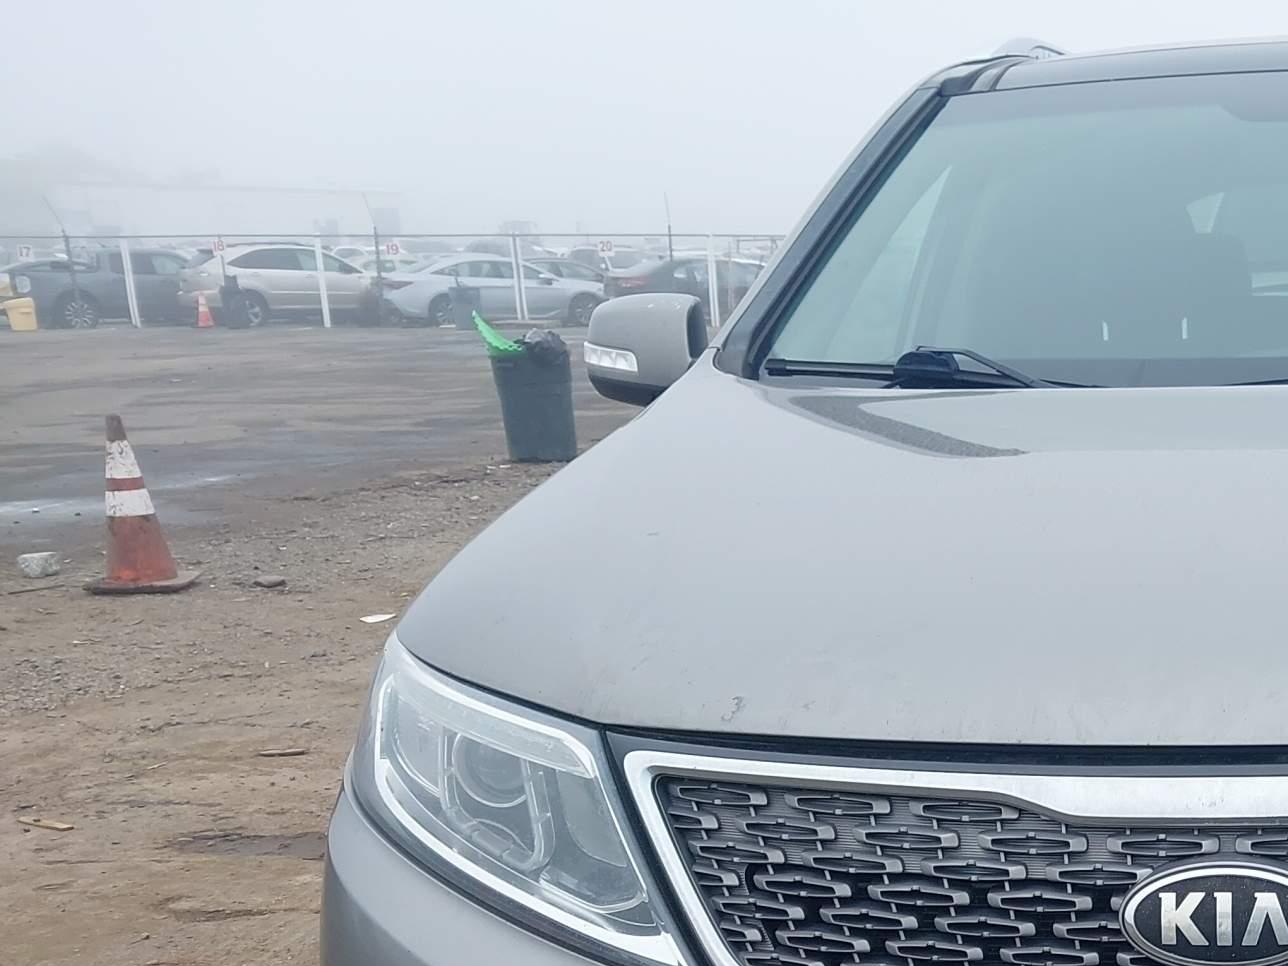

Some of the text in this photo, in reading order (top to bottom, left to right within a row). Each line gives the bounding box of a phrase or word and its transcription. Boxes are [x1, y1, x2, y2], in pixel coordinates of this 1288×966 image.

[17, 246, 31, 257] 17
[213, 240, 225, 252] 18
[386, 243, 399, 255] 19
[599, 241, 613, 252] 20
